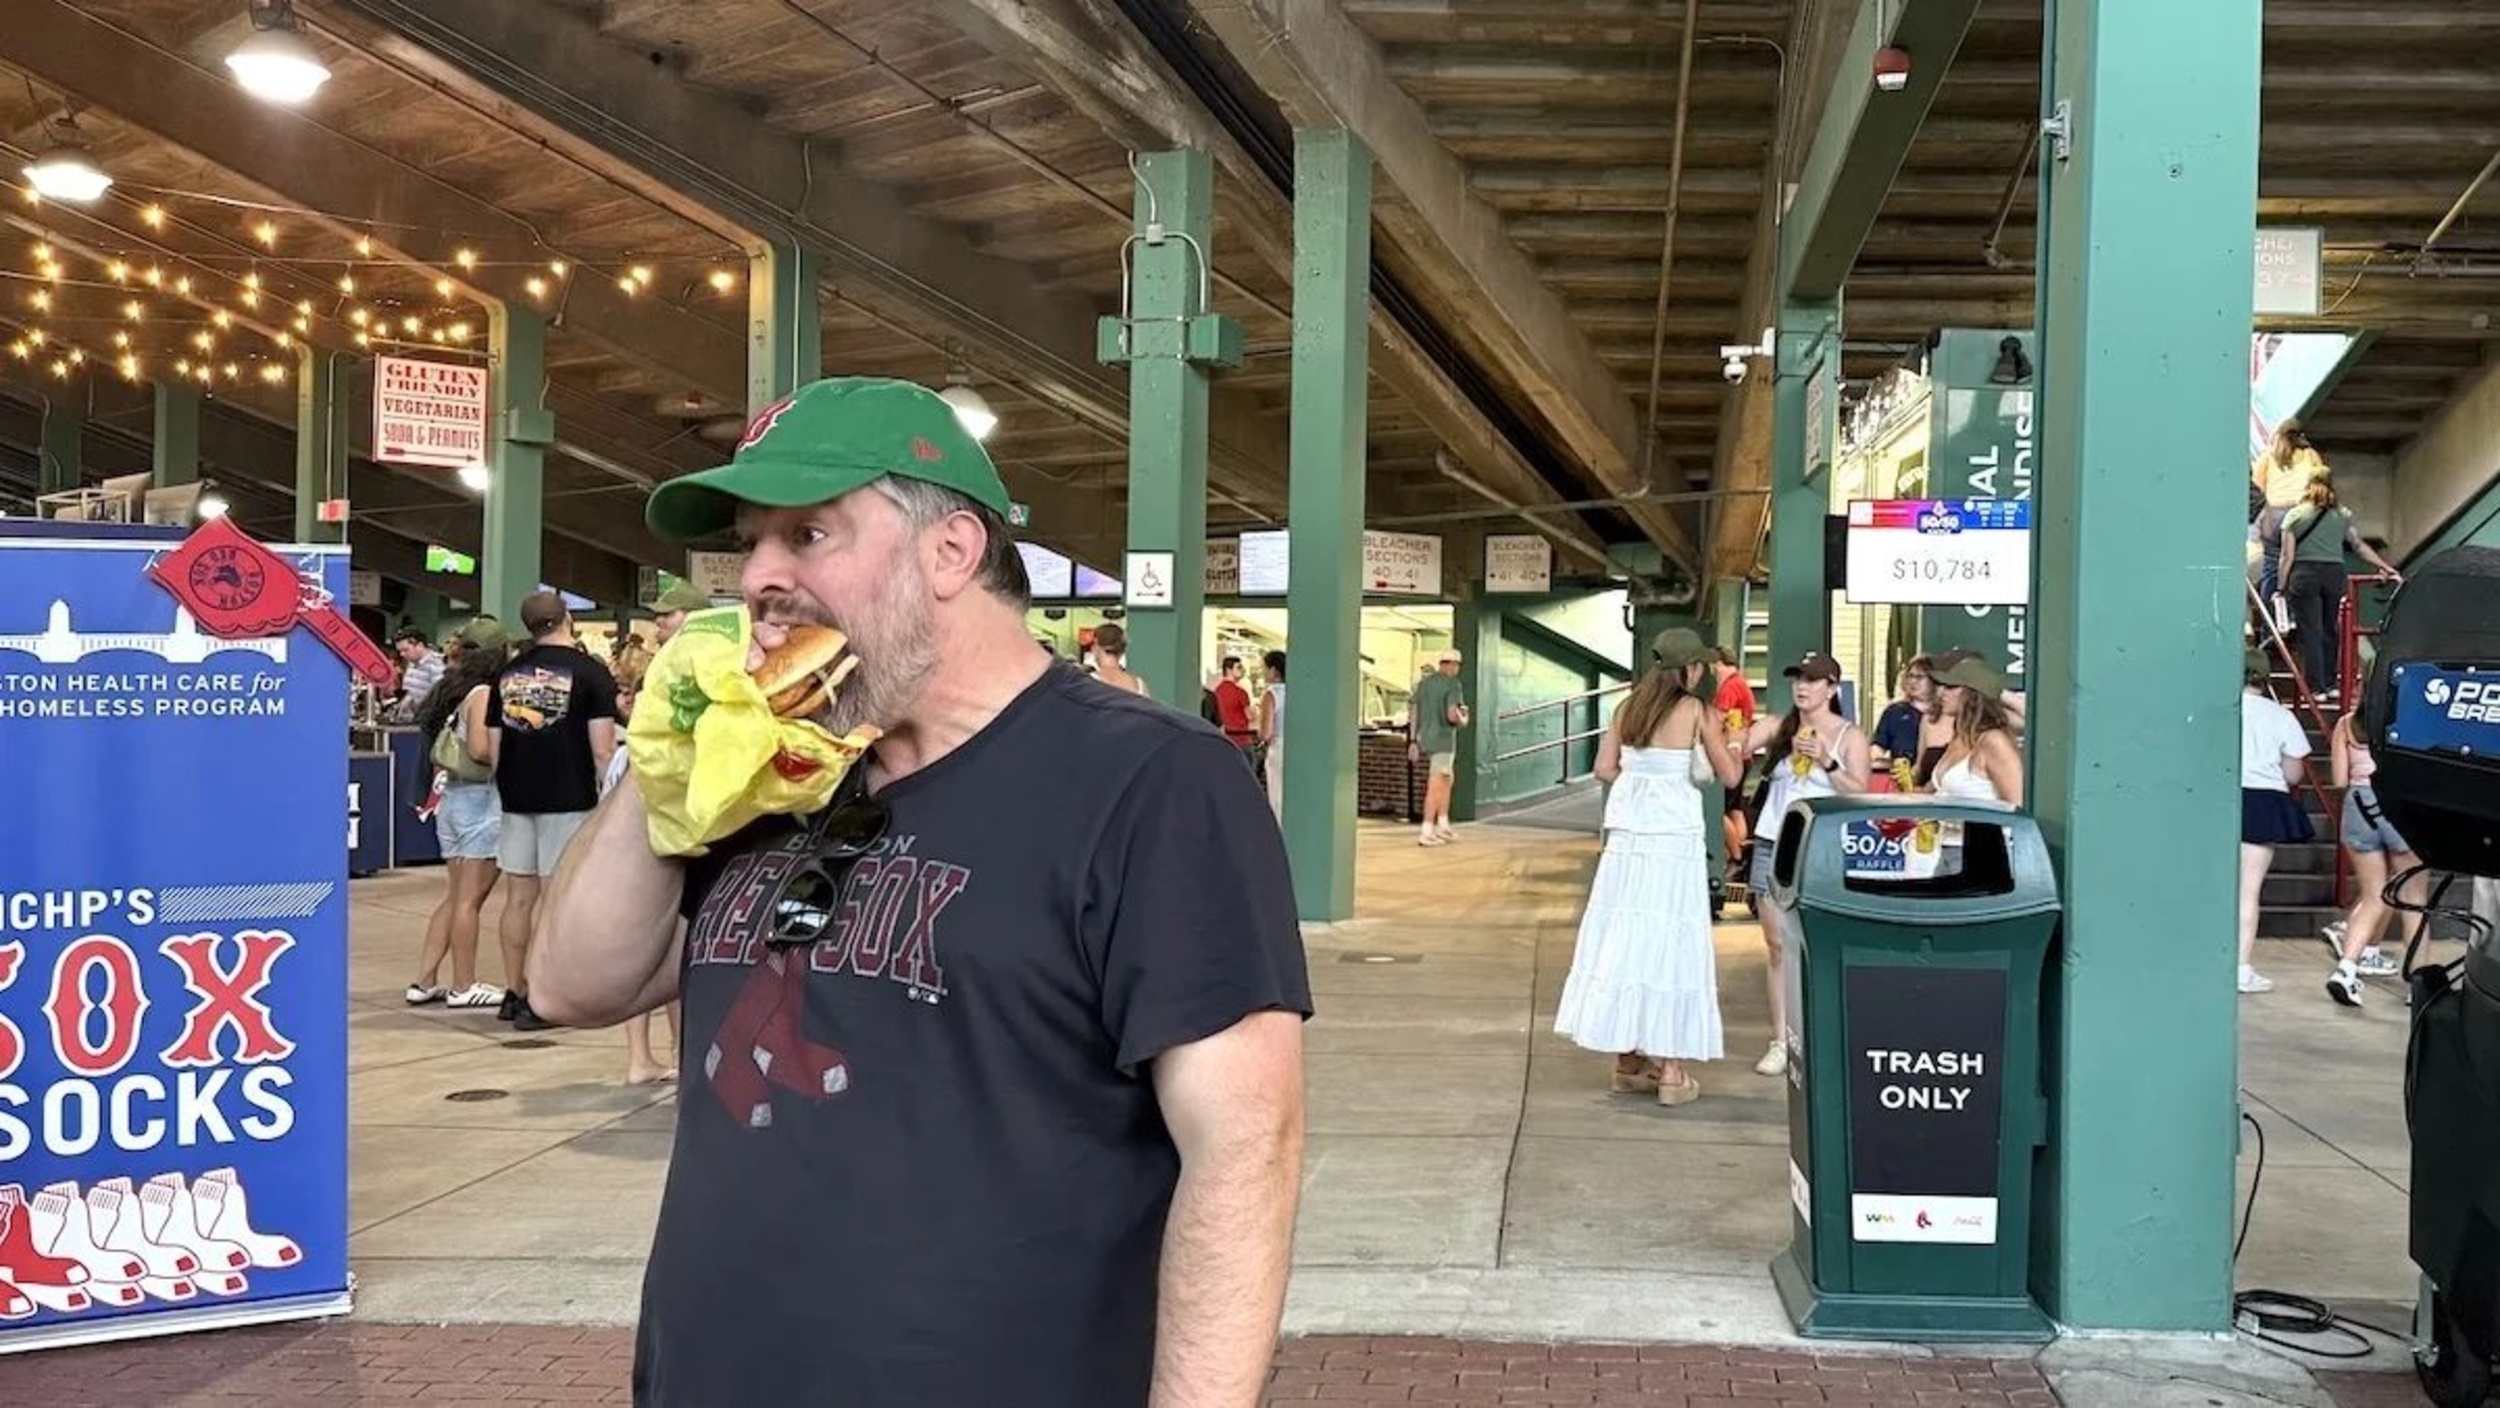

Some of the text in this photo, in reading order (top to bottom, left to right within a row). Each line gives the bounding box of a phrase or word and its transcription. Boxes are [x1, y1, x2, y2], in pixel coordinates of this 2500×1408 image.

[386, 364, 480, 386] GLUTEN
[386, 379, 480, 398] FRIENDLY
[384, 398, 481, 420] VEGETARIAN
[1366, 549, 1429, 565] SECTIONS
[1373, 566, 1391, 579] 40
[1405, 568, 1419, 580] 41
[1892, 557, 1992, 583] $10,784
[68, 674, 168, 692] HEALTH
[177, 674, 243, 692] CARE
[250, 672, 286, 697] for
[0, 698, 286, 717] HOMELESS PROGRAM
[1855, 859, 1903, 869] RAFFLE
[810, 856, 971, 993] SOX
[0, 929, 296, 1077] OX
[1866, 1050, 1983, 1075] TRASH
[1880, 1085, 1971, 1110] ONLY
